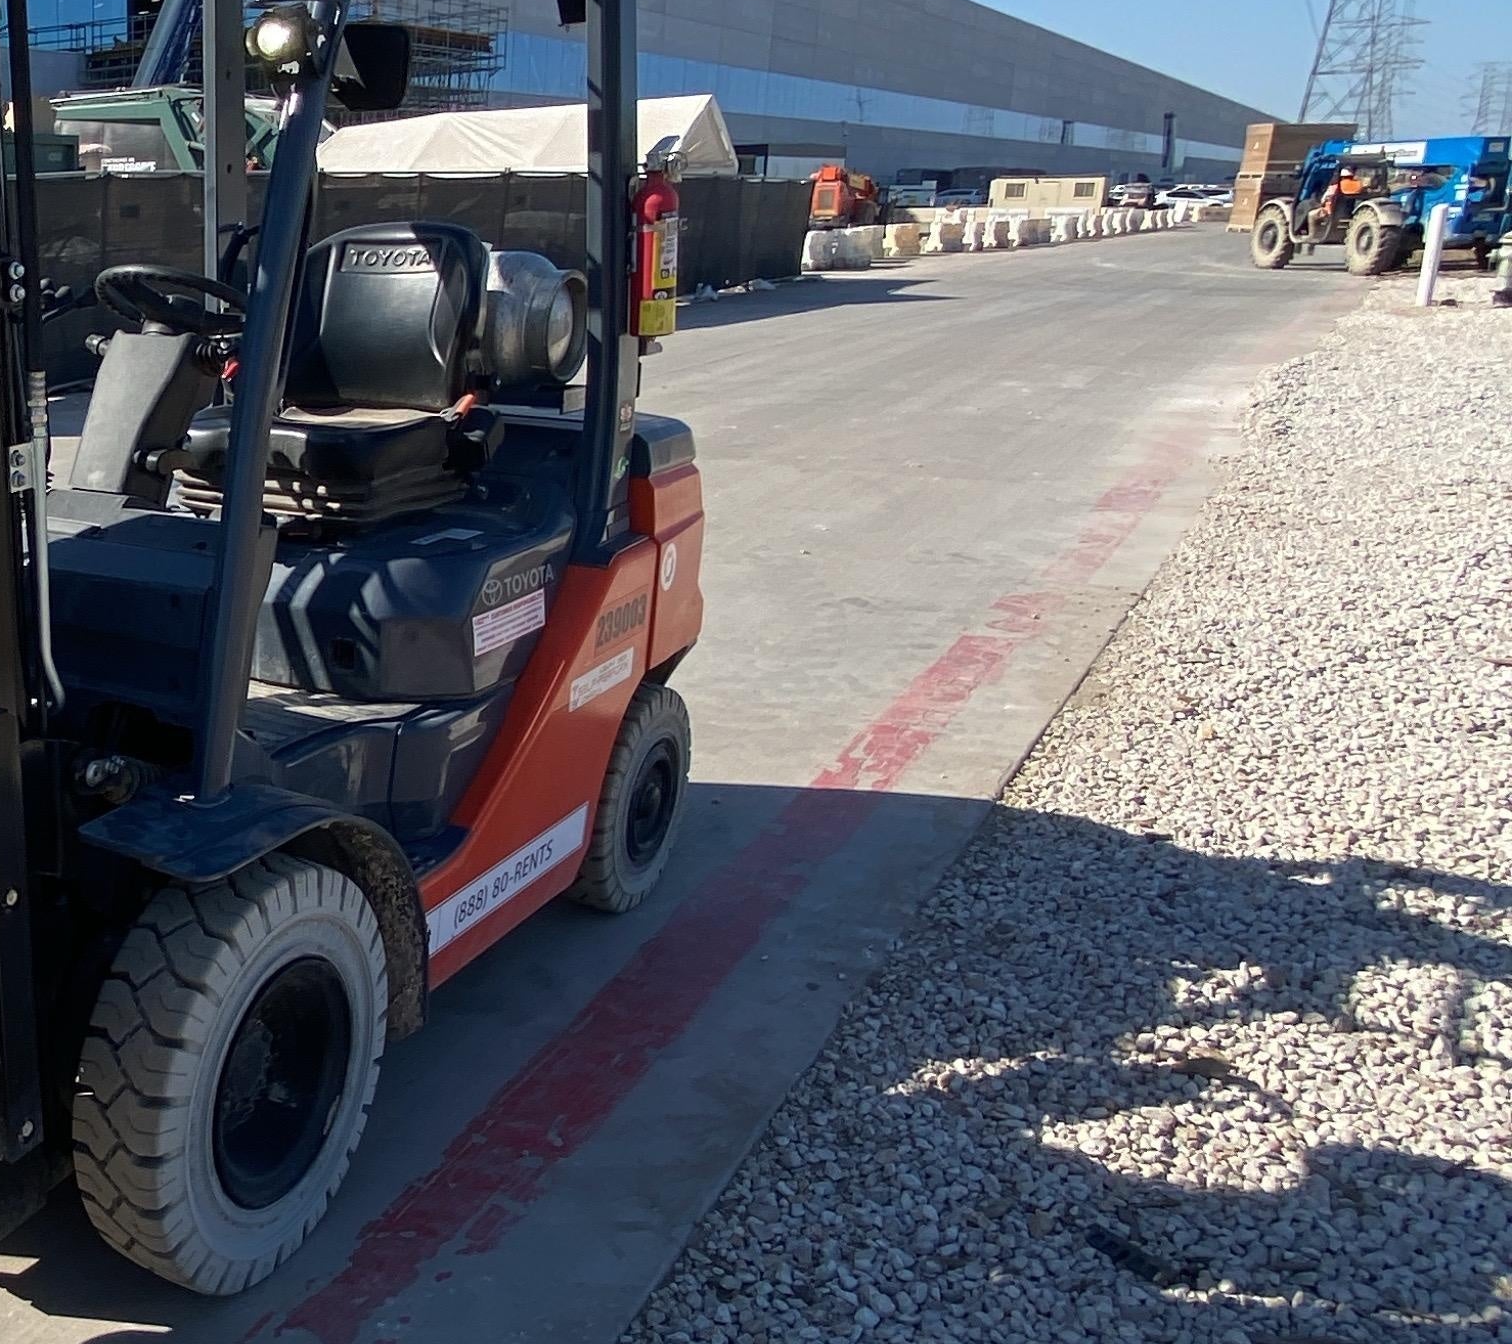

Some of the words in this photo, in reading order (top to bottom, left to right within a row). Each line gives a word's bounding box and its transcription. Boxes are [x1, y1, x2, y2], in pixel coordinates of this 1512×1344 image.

[349, 248, 432, 267] TOYOTA
[503, 563, 555, 597] TOYOTA
[595, 592, 648, 649] 239003
[453, 884, 488, 930] (888)
[491, 838, 555, 899] 80-RENTS
